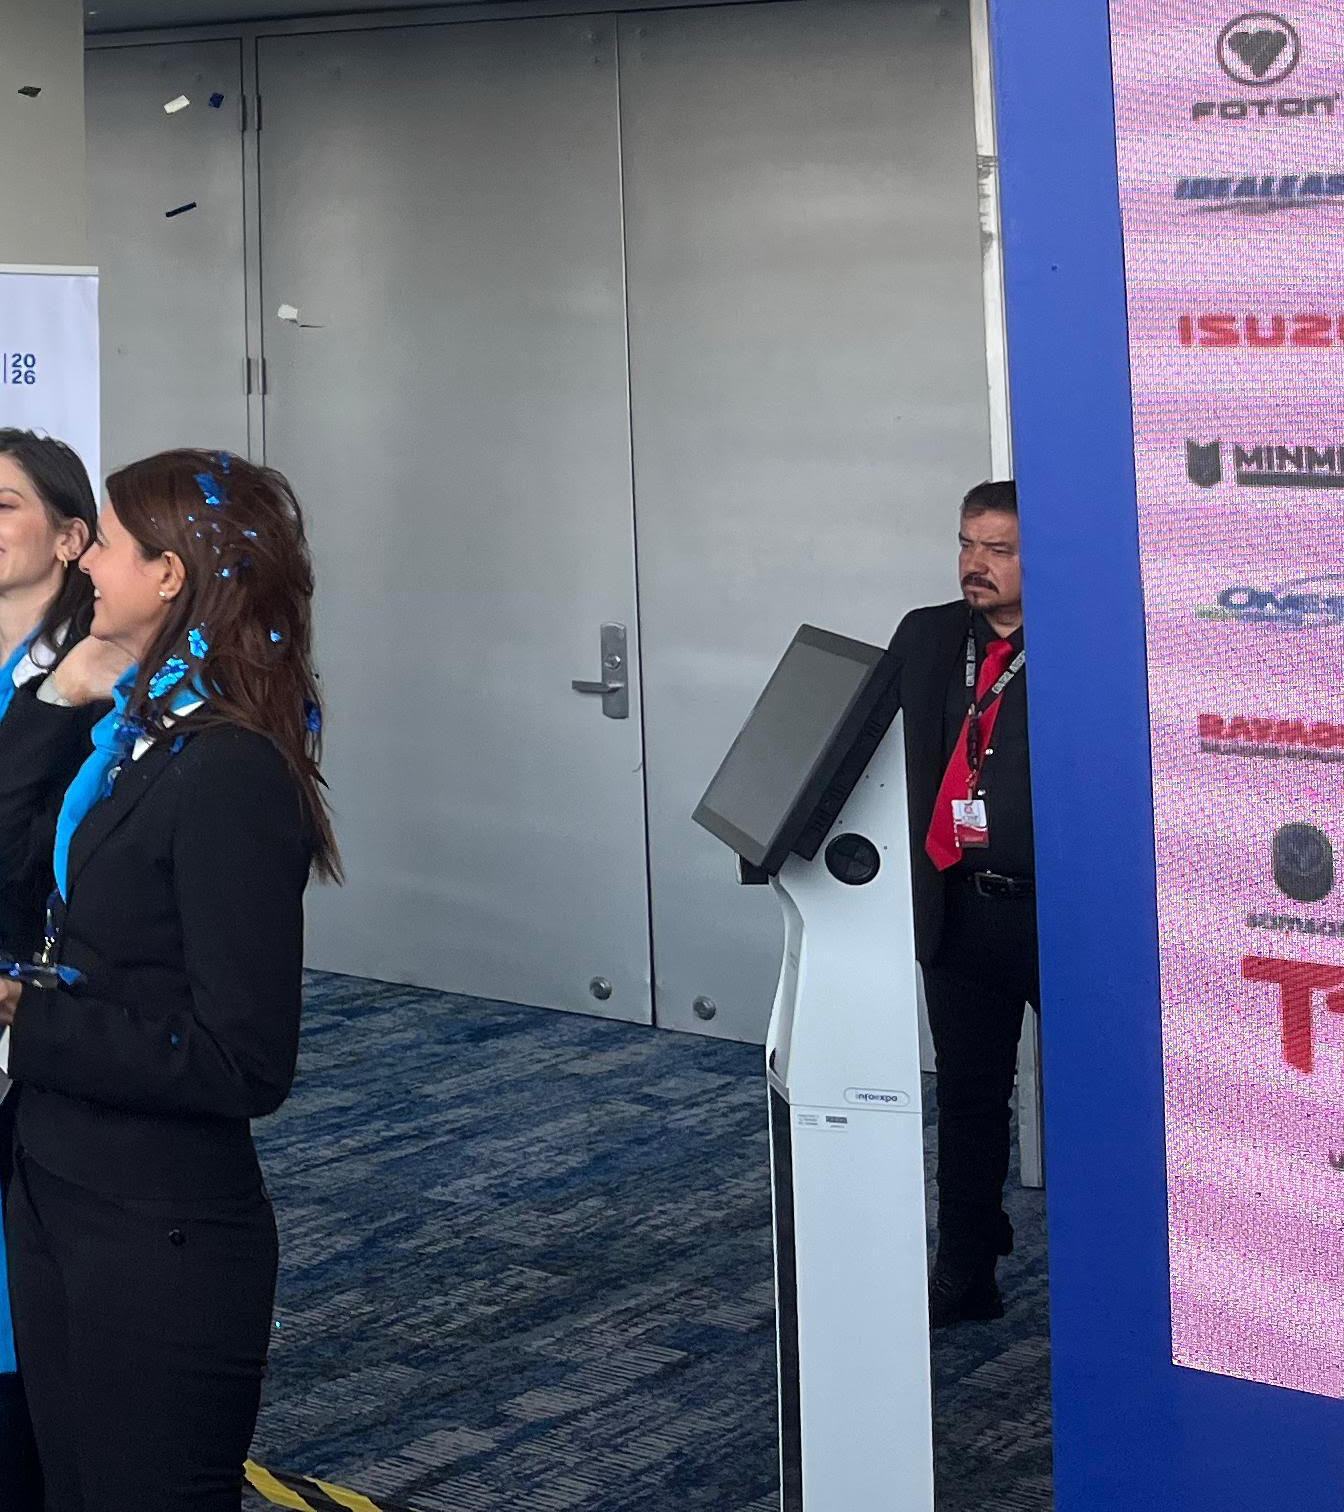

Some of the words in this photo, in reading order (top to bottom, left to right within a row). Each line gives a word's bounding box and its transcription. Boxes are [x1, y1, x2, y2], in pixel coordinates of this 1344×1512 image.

[1178, 312, 1344, 348] ISUZ
[11, 353, 37, 368] 20
[11, 369, 36, 385] 26
[1234, 443, 1344, 472] MINM
